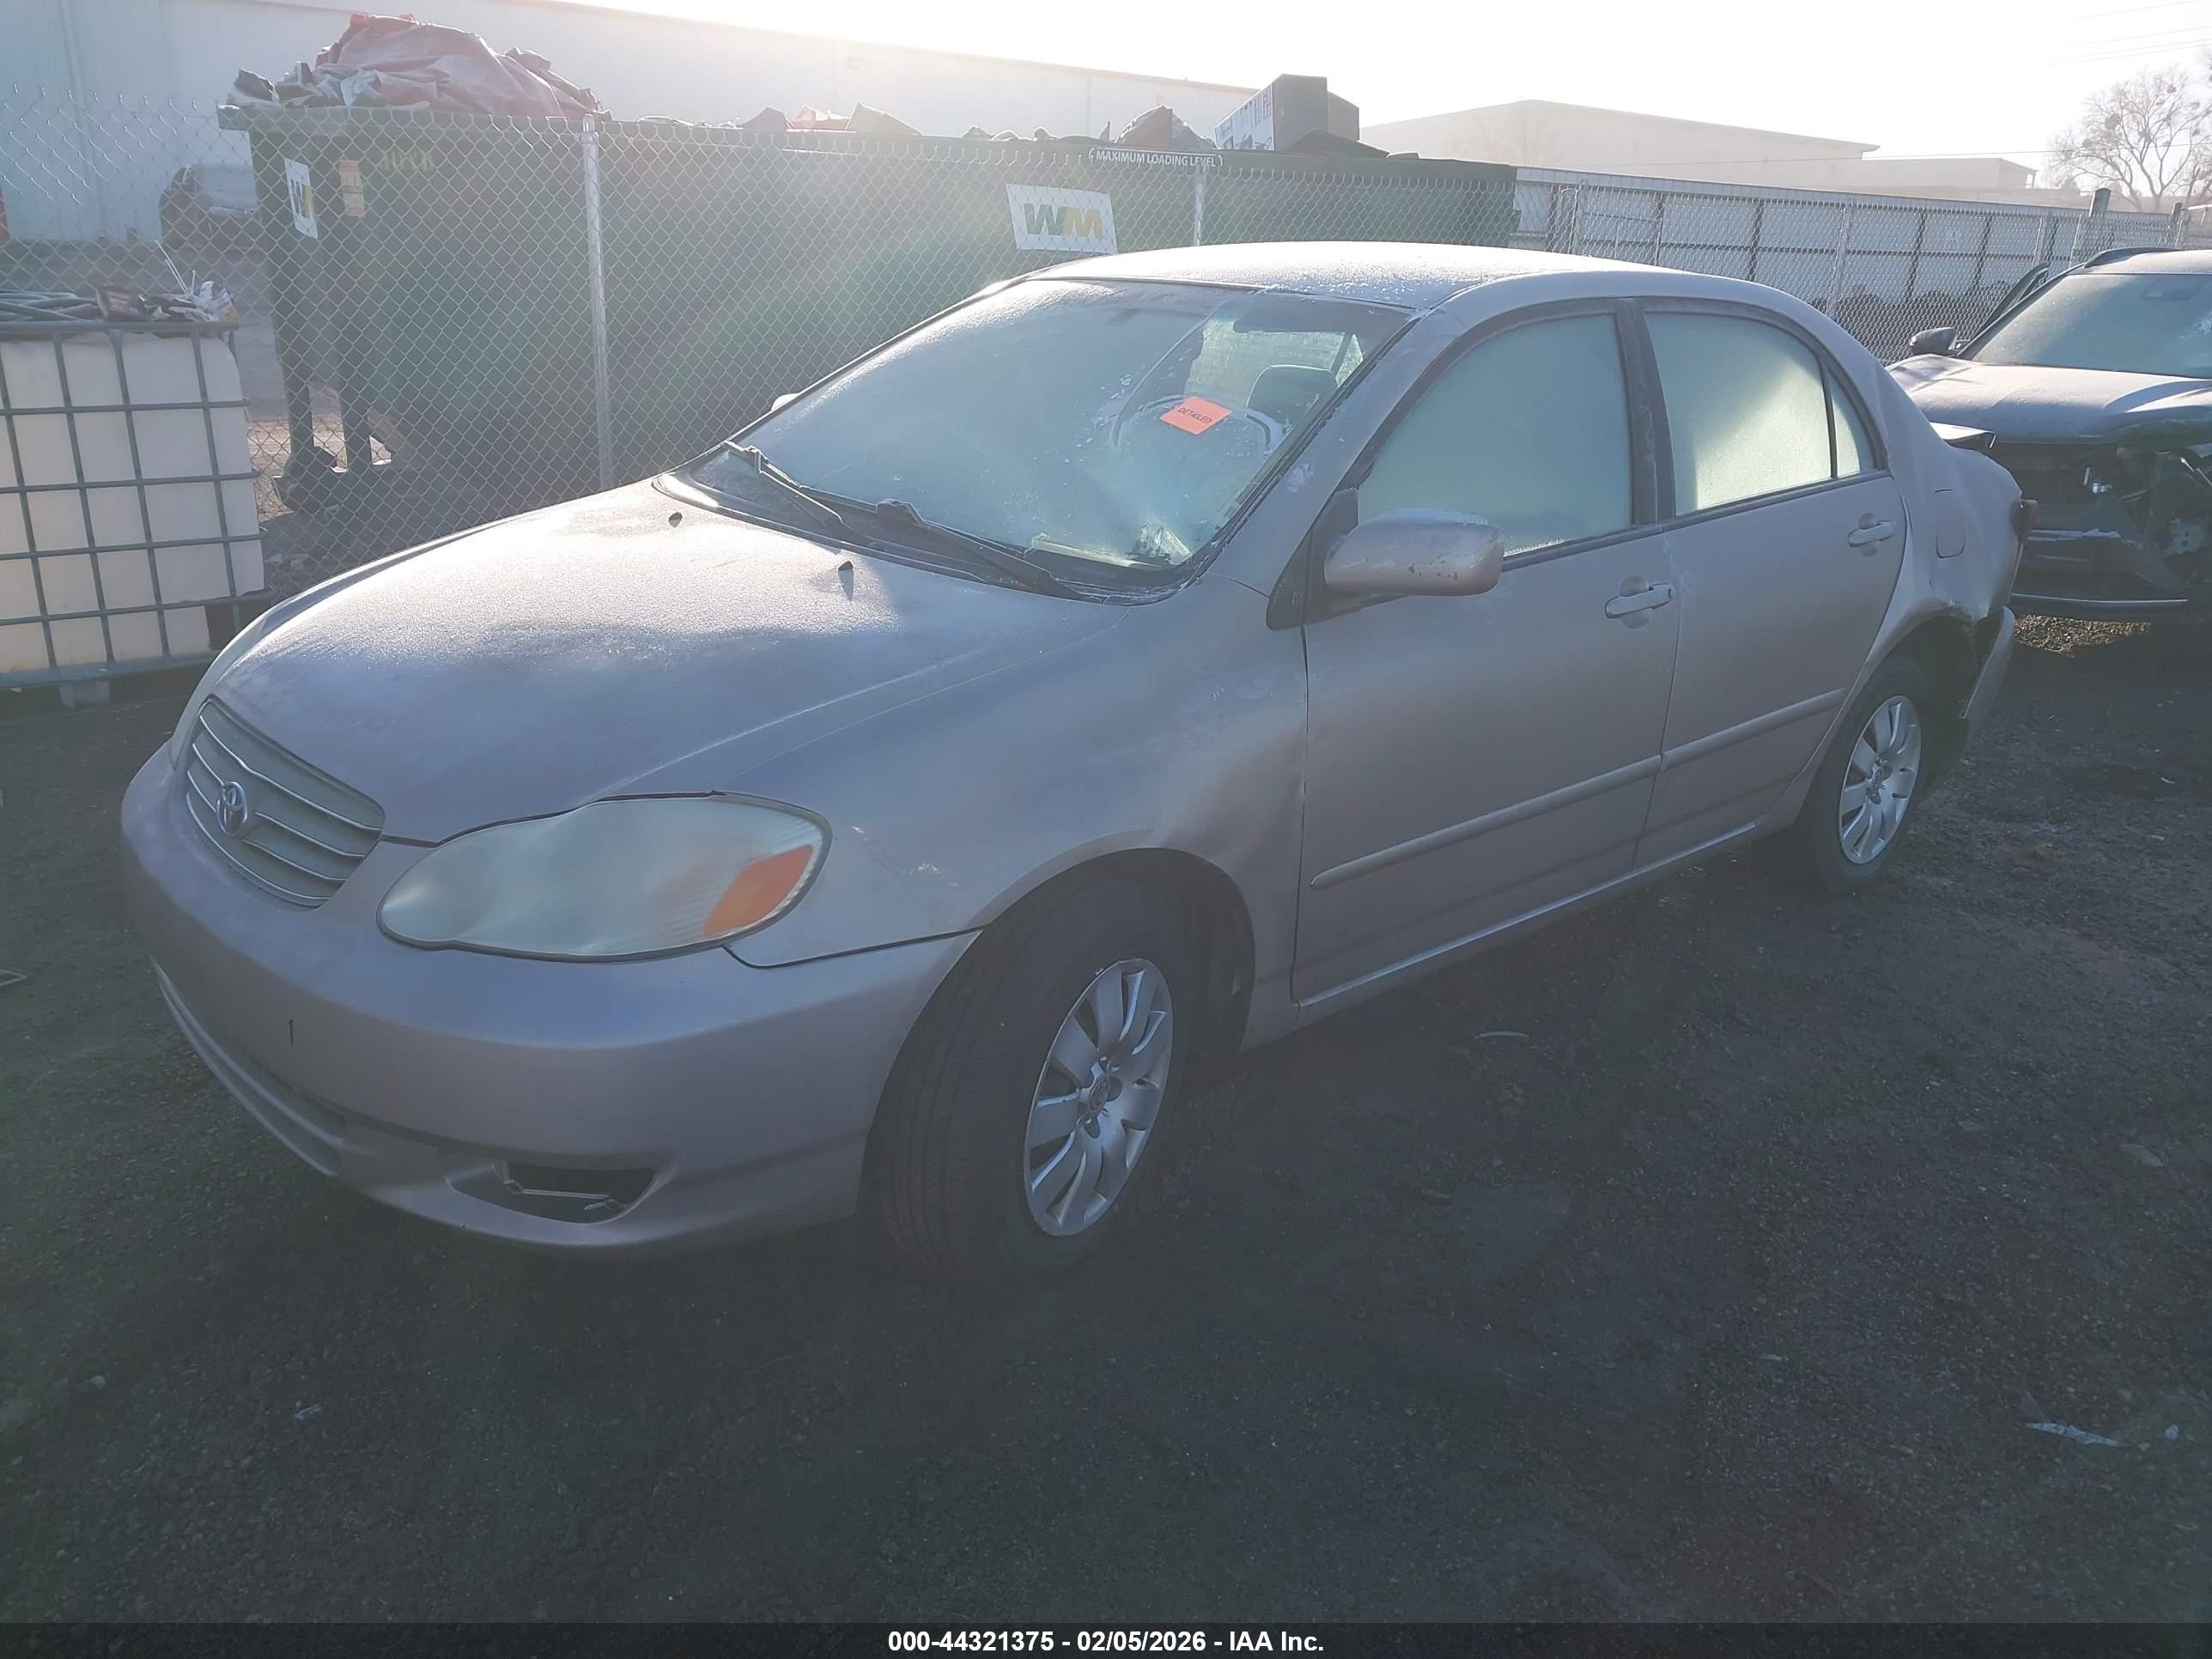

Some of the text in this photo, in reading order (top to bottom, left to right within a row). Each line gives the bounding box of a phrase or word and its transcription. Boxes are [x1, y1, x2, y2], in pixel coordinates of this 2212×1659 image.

[1096, 150, 1216, 167] MAXIMUM LOADING LEVEL
[1023, 203, 1103, 239] WM
[1177, 407, 1212, 424] DETAILED
